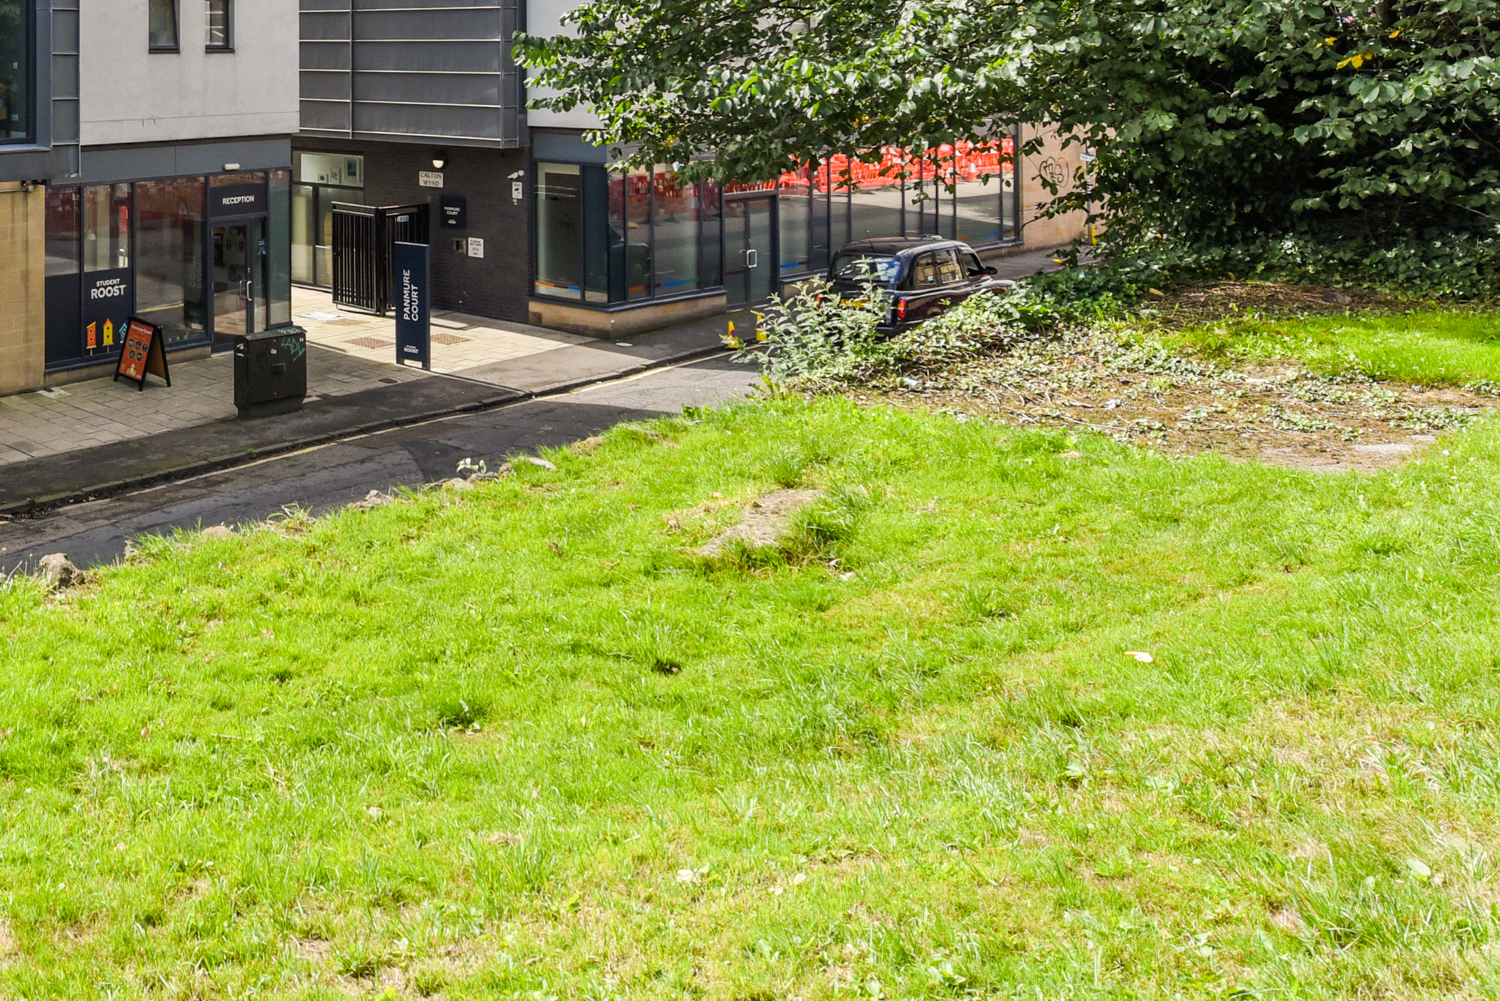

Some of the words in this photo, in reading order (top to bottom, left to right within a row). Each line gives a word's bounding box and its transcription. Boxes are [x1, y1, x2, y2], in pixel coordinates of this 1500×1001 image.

[222, 195, 255, 205] RECEPTION
[96, 278, 120, 287] STUDENT
[91, 284, 126, 299] ROOST
[403, 269, 411, 320] PANMURE
[411, 284, 419, 321] COURT
